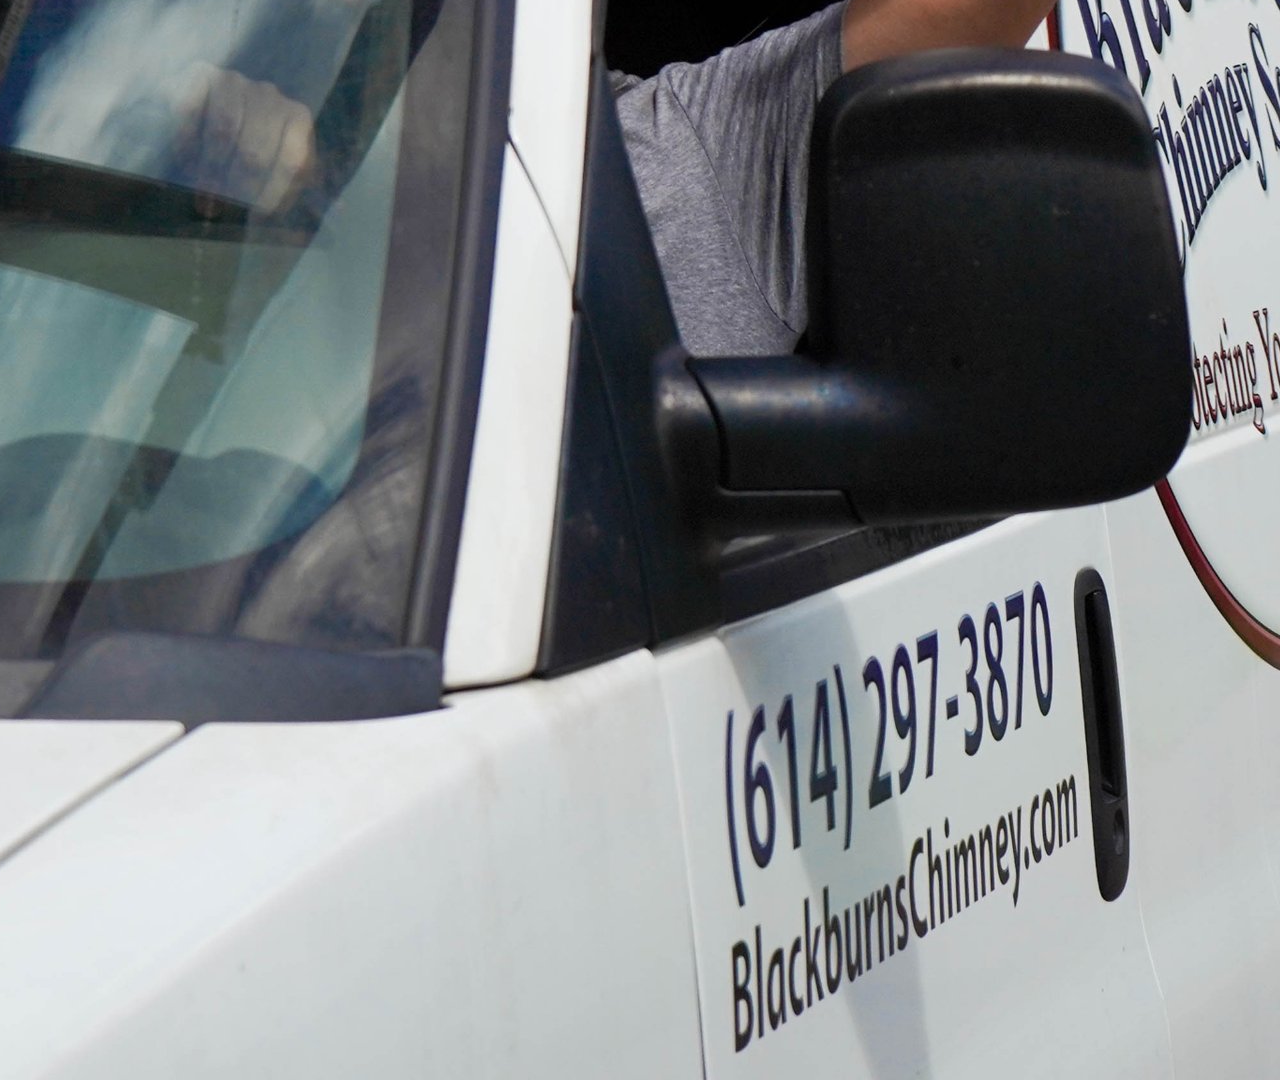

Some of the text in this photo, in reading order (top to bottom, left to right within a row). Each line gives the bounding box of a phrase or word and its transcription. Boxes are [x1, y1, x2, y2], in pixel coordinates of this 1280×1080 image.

[1192, 317, 1266, 435] tecting
[724, 580, 1055, 909] (614) 297-3870
[731, 773, 1080, 1054] BlackburnsChimney.com
